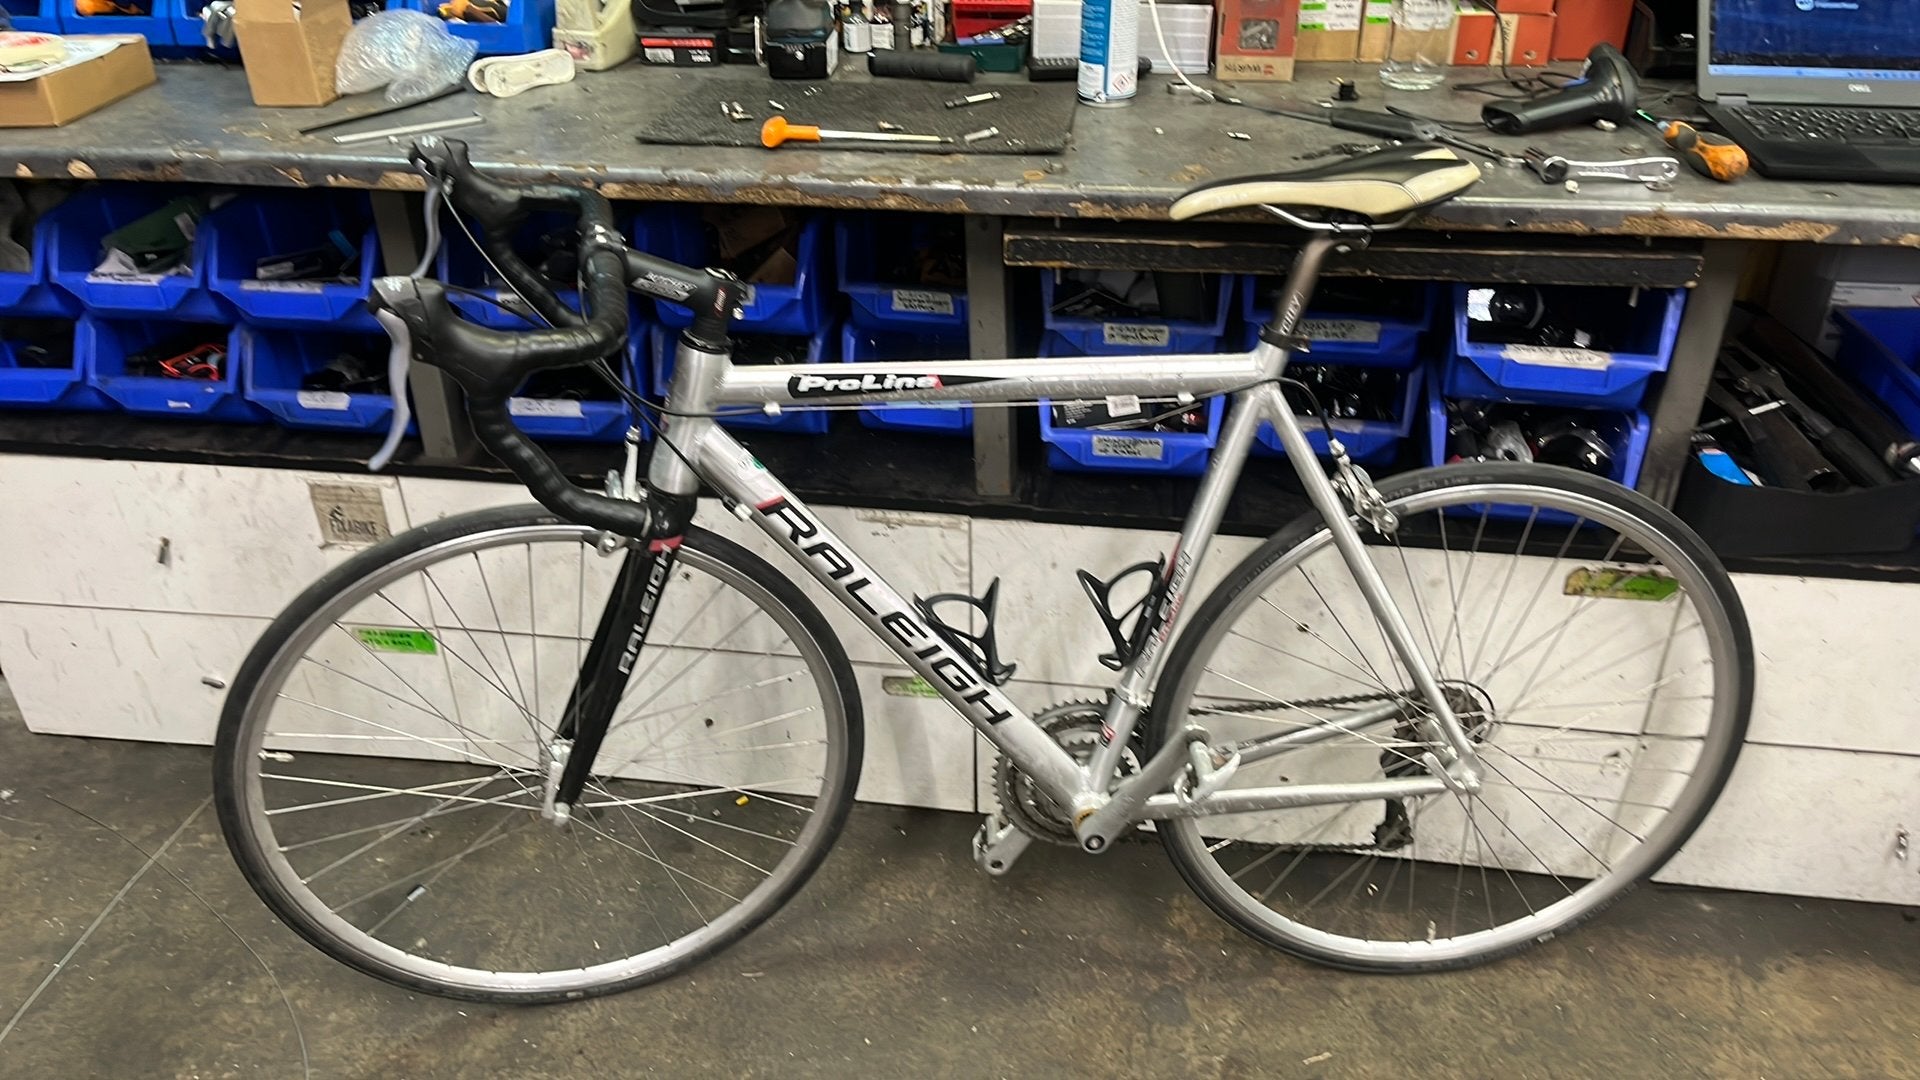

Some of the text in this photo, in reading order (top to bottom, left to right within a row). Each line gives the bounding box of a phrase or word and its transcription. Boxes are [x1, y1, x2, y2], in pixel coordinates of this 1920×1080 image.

[797, 374, 942, 392] ProLine
[618, 542, 672, 675] RALEIGH
[757, 496, 1014, 726] RALEIGH
